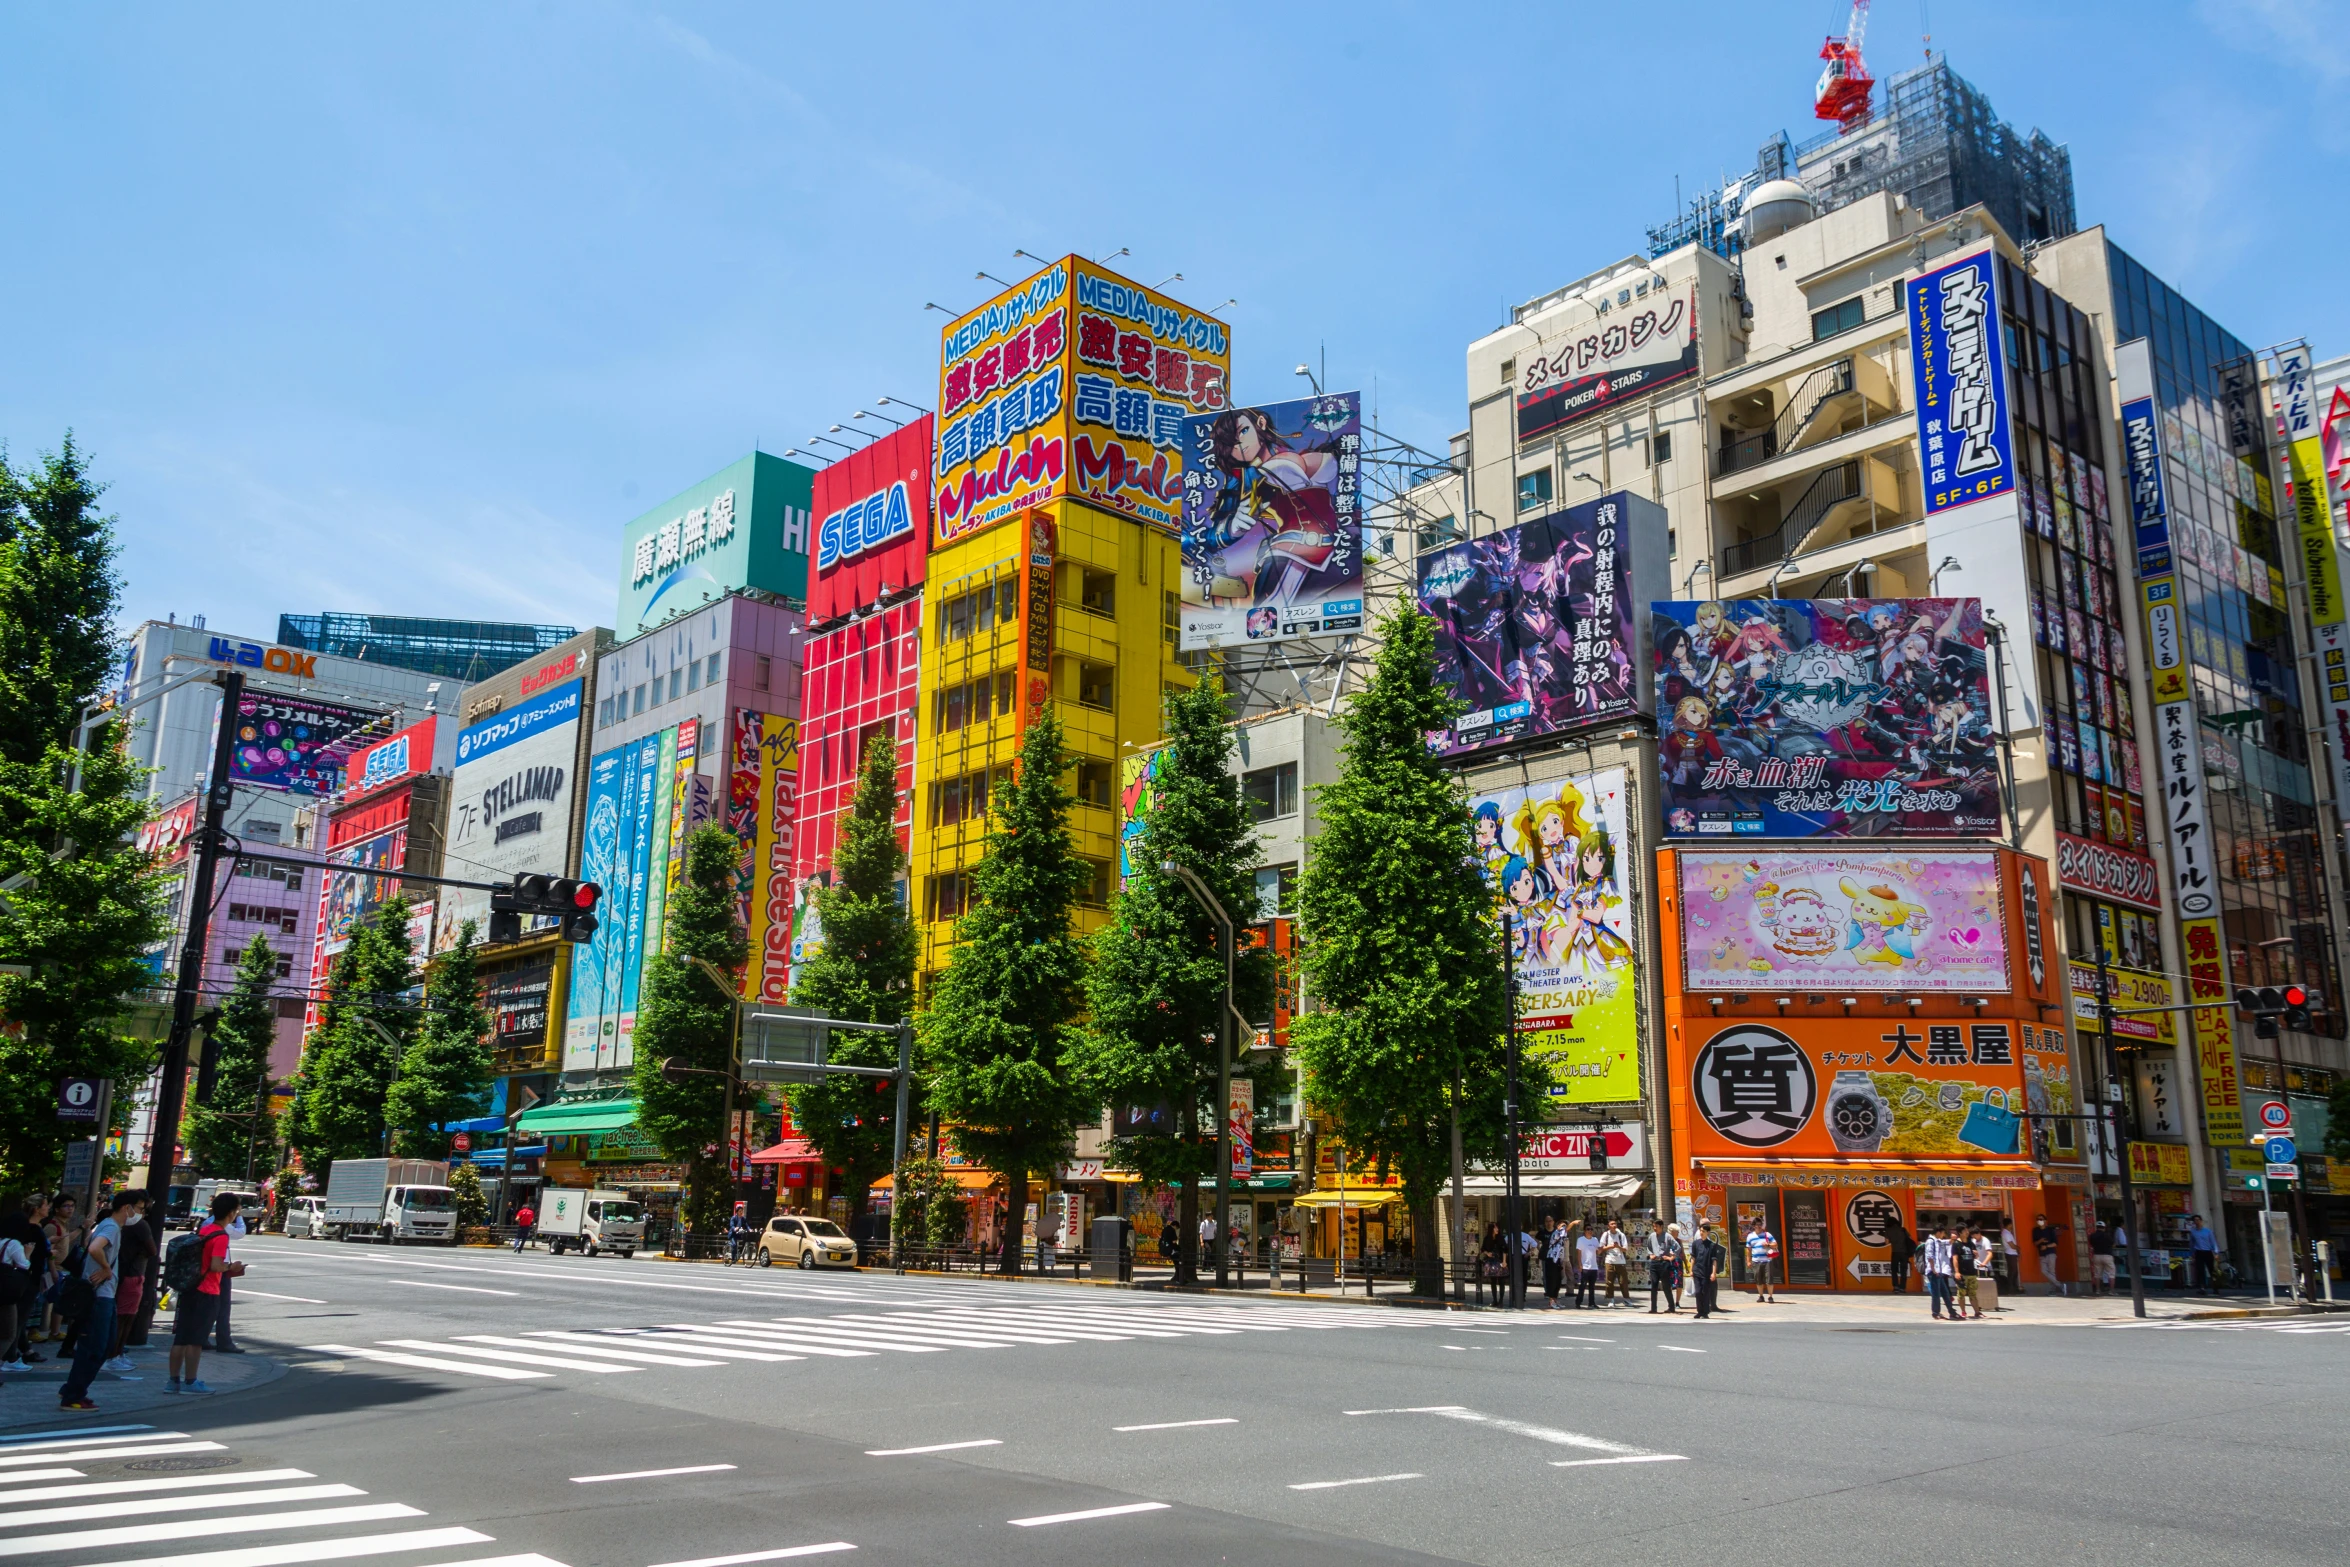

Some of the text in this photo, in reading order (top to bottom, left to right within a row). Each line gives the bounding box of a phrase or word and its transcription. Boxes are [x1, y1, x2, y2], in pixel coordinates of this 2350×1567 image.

[944, 264, 1067, 367] MEDIAリサイクル
[1077, 272, 1227, 356] MEDIAリサイクル
[943, 307, 1065, 417] 激安販売
[1077, 312, 1226, 411] 激安販売
[1524, 300, 1685, 391] メイドカジノ
[1918, 295, 1938, 401] トレーディングカードゲーム
[1941, 266, 2002, 478] アメニティドリーム
[1564, 384, 1595, 410] POKER
[2283, 355, 2311, 432] スーパービル
[940, 364, 1062, 477] 高額買取
[1194, 423, 1218, 490] いつでも
[1926, 419, 1946, 485] 秋葉原店
[2127, 416, 2162, 528] アメニティドリーム
[938, 434, 1065, 540] Mulan
[1089, 486, 1171, 526] ムーラン AKIBA
[1331, 434, 1359, 576] 準備は整ったぞ。
[817, 480, 915, 572] SEGA
[949, 485, 1052, 541] ムーラン AKIBA 中央通り店
[2036, 508, 2053, 538] 7F
[631, 488, 736, 584] 廣瀬無線
[1183, 469, 1214, 600] 命令してくれ！
[2295, 478, 2330, 618] Yellow Submarine
[1032, 567, 1050, 580] DVD
[1591, 502, 1618, 684] 我の射程内にのみ
[2151, 586, 2168, 599] 3F
[1030, 590, 1049, 602] ゲーム
[1033, 602, 1046, 613] CD
[1284, 606, 1316, 618] アズレン
[1340, 601, 1356, 612] 検索
[1029, 613, 1048, 625] アイドル
[1029, 624, 1048, 637] アニメ
[1197, 621, 1224, 632] Yostar
[2155, 607, 2173, 667] りらくる
[2320, 625, 2340, 637] 5F
[209, 637, 317, 679] Laox
[1030, 647, 1047, 659] ホビー
[1572, 617, 1594, 709] 真理あり
[520, 653, 577, 695] ビックカメラ
[2326, 649, 2348, 702] 秋葉館
[467, 695, 502, 719] Sofmap
[1509, 705, 1525, 717] 検索
[1606, 698, 1630, 708] Yostar
[1753, 675, 1891, 714] アズールレーン
[258, 703, 352, 728] ラブメルシー
[472, 713, 521, 750] ソフマップ
[1459, 715, 1488, 728] アズレン
[364, 734, 411, 790] SEGA
[2061, 741, 2077, 767] 5F
[483, 766, 564, 826] STELLAMAP
[1773, 780, 1962, 812] それは栄光を求む
[456, 803, 478, 842] 7F
[509, 819, 528, 834] Cafe
[1701, 823, 1728, 831] アズレン
[1965, 815, 1997, 825] Yostar
[1771, 863, 1804, 879] @home
[1836, 859, 1907, 884] Pompompurin
[2058, 839, 2155, 901] メイドカジノ
[1938, 954, 1997, 966] @home cafe
[2186, 925, 2224, 998] 免税
[1529, 977, 1561, 988] THEATER
[1563, 976, 1583, 985] DAYS
[1546, 1034, 1567, 1046] 7.15
[1822, 1023, 2014, 1067] チケット 大黒屋
[1707, 1042, 1807, 1132] 質
[2219, 1051, 2239, 1107] FREE
[2151, 1073, 2171, 1132] ルノアール
[2267, 1109, 2284, 1121] 40
[2209, 1122, 2243, 1130] AKIHABARA
[2271, 1144, 2283, 1160] P
[1707, 1172, 1754, 1185] 高価買取
[1991, 1175, 2040, 1188] 無料査定
[1070, 1196, 1078, 1236] KIRIN
